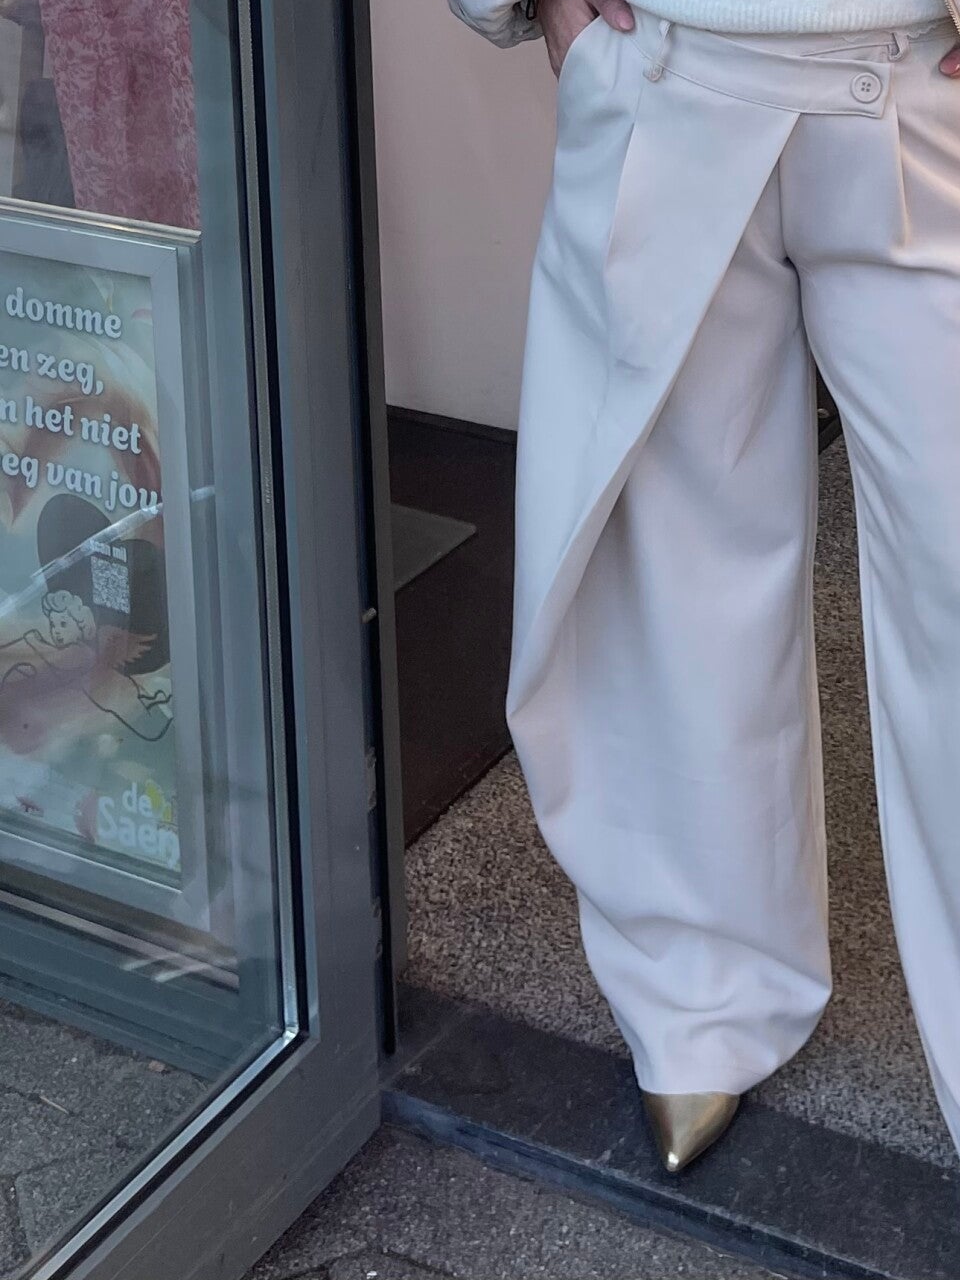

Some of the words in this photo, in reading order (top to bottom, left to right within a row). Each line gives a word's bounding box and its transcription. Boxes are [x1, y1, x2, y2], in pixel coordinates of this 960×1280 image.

[5, 286, 122, 339] domme
[37, 352, 104, 395] zeg,
[25, 395, 74, 436] het
[80, 413, 142, 455] niet
[46, 462, 102, 499] van
[105, 470, 159, 515] jou
[121, 781, 153, 819] de
